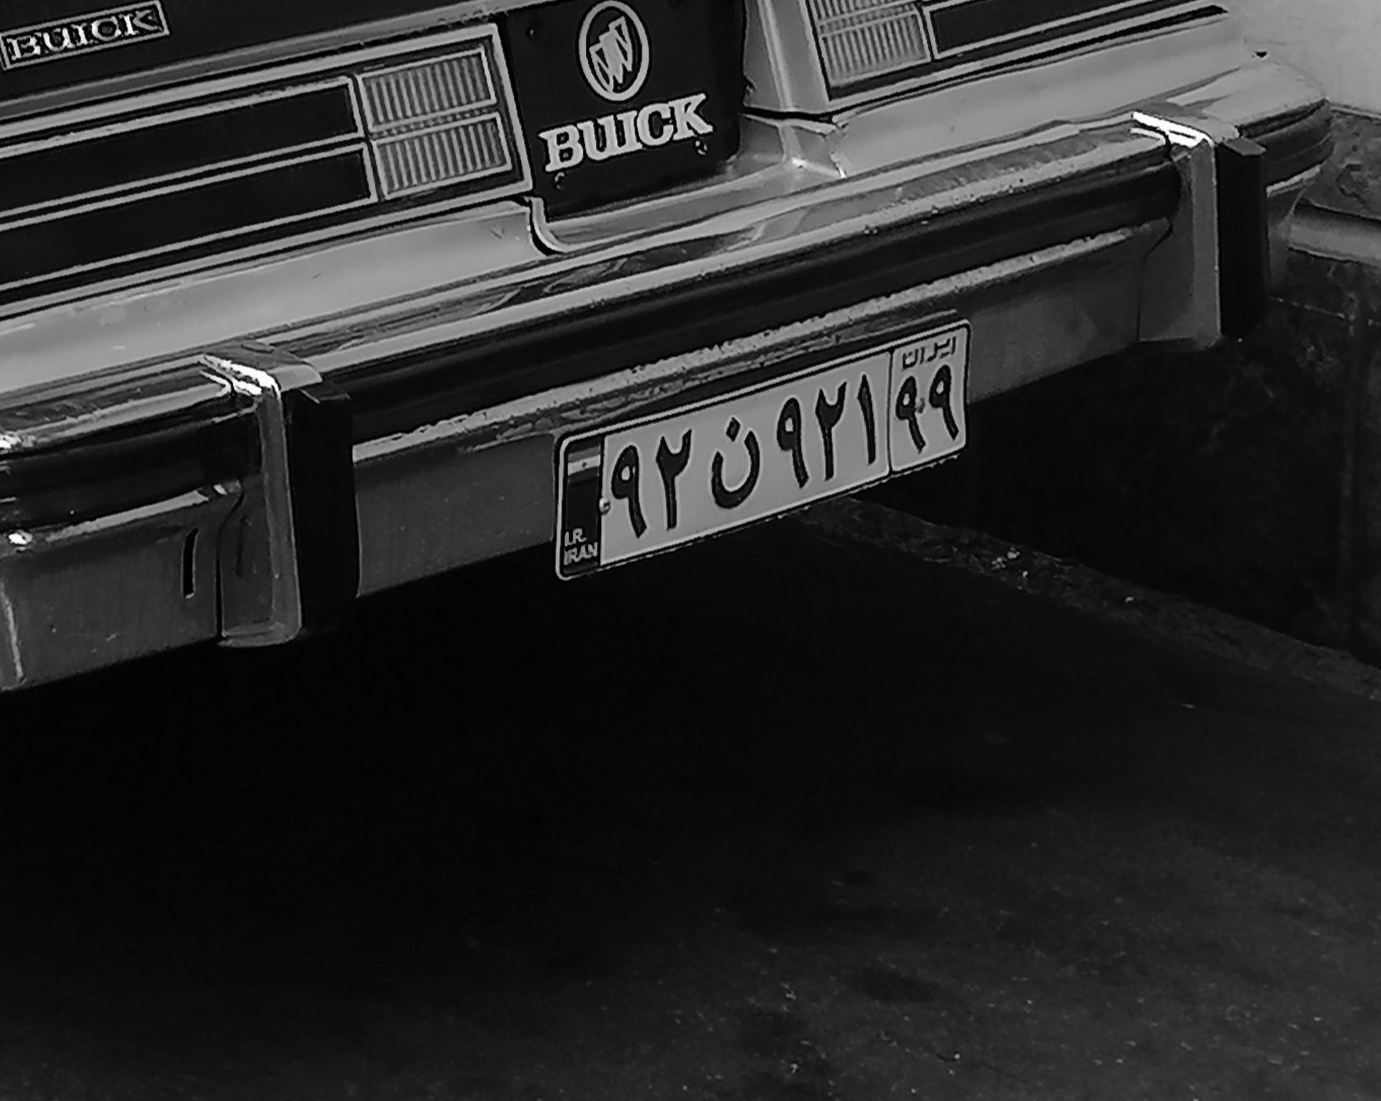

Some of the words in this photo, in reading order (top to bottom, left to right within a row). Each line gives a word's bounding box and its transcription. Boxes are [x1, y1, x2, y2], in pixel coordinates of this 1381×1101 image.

[7, 9, 163, 61] BUICK
[538, 93, 713, 172] BUICK
[902, 336, 956, 371] ایران
[563, 541, 598, 566] IRAN
